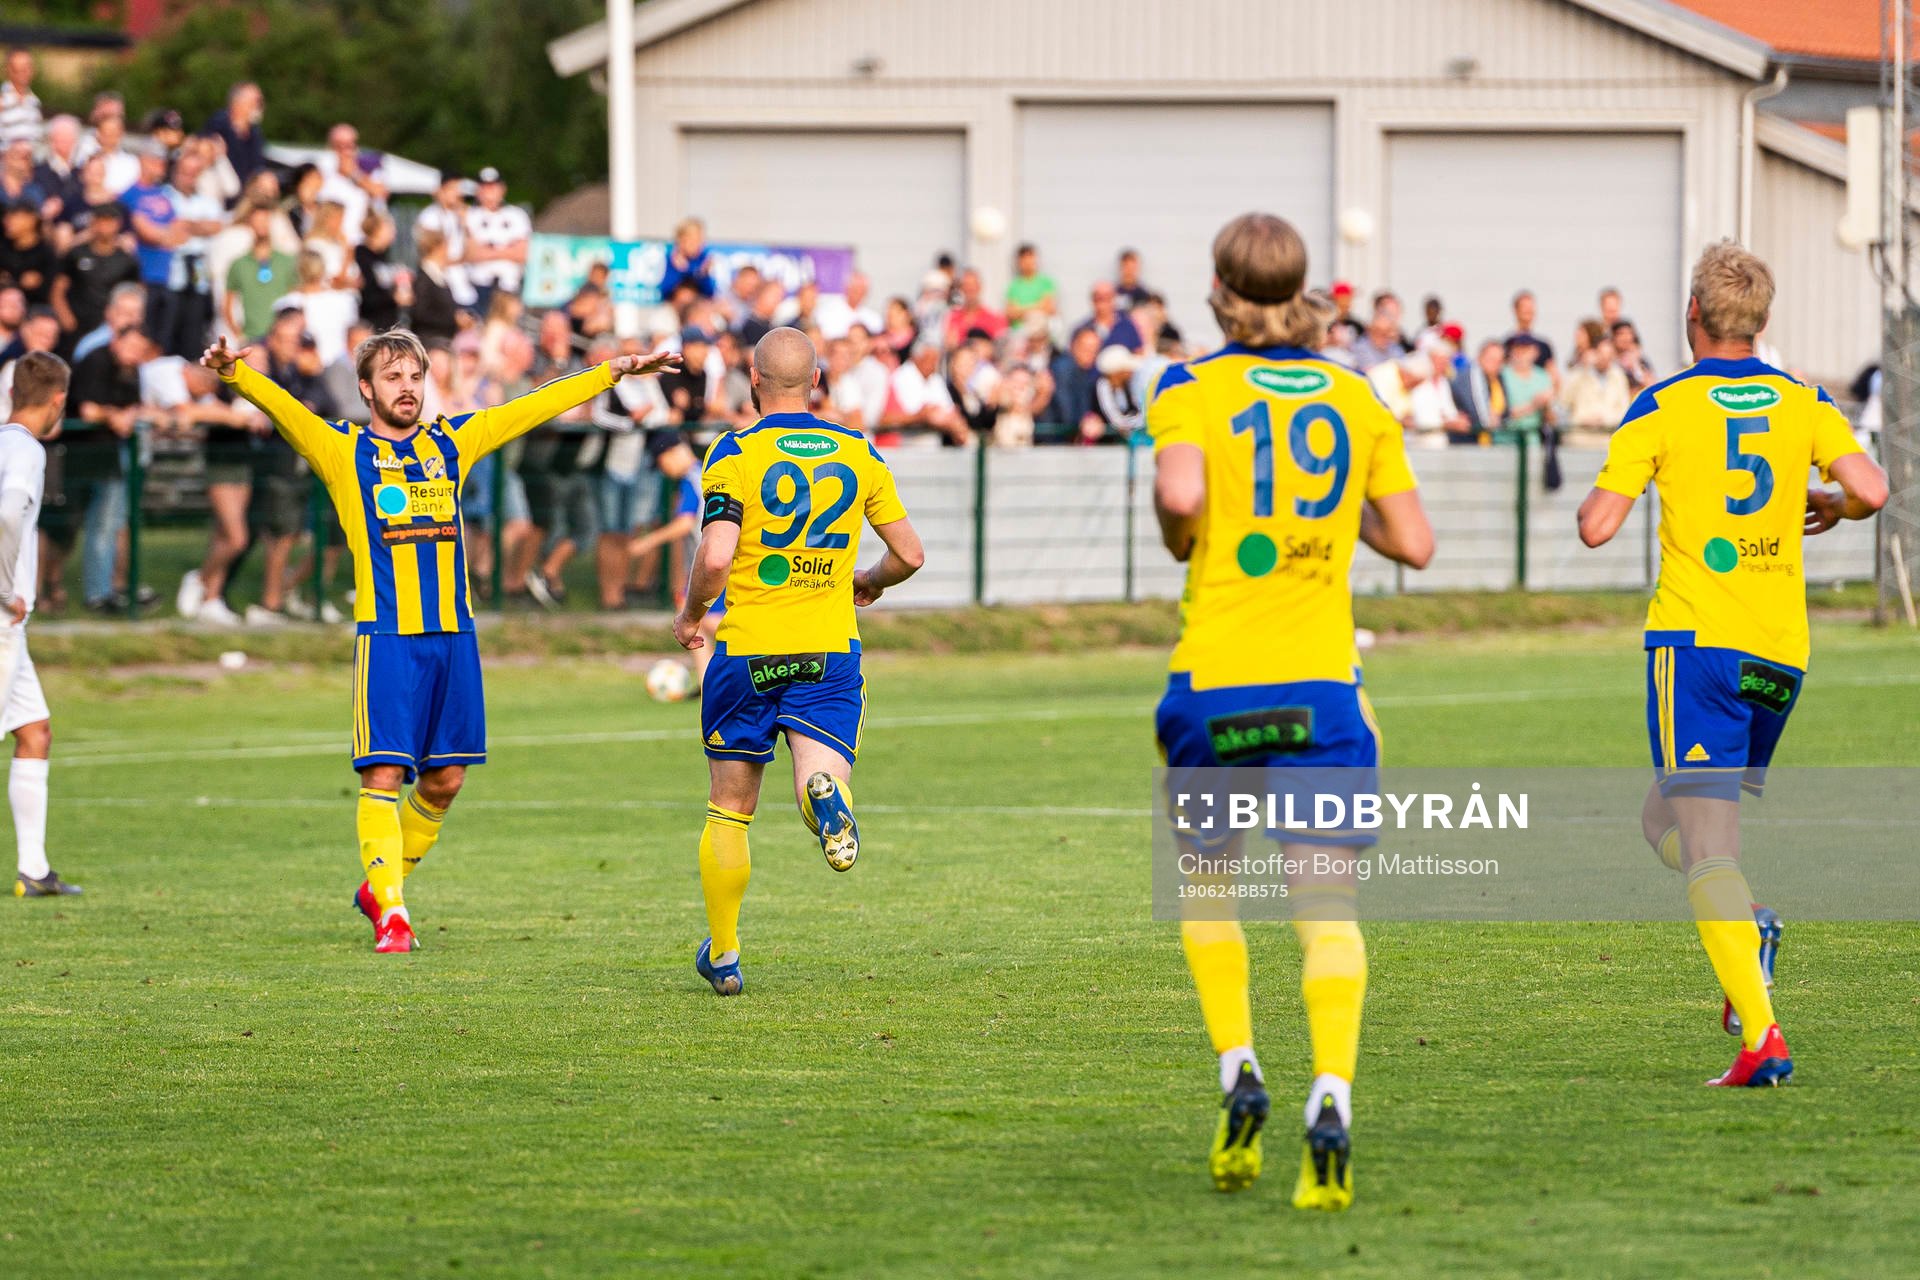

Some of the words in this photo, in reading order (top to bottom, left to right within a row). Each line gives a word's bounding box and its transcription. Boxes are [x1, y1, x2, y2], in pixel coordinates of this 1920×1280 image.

[1230, 400, 1350, 519] 19
[1726, 416, 1774, 516] 5
[760, 460, 858, 549] 92
[792, 555, 834, 576] Solid
[1738, 537, 1780, 557] Solid
[753, 662, 800, 684] akea
